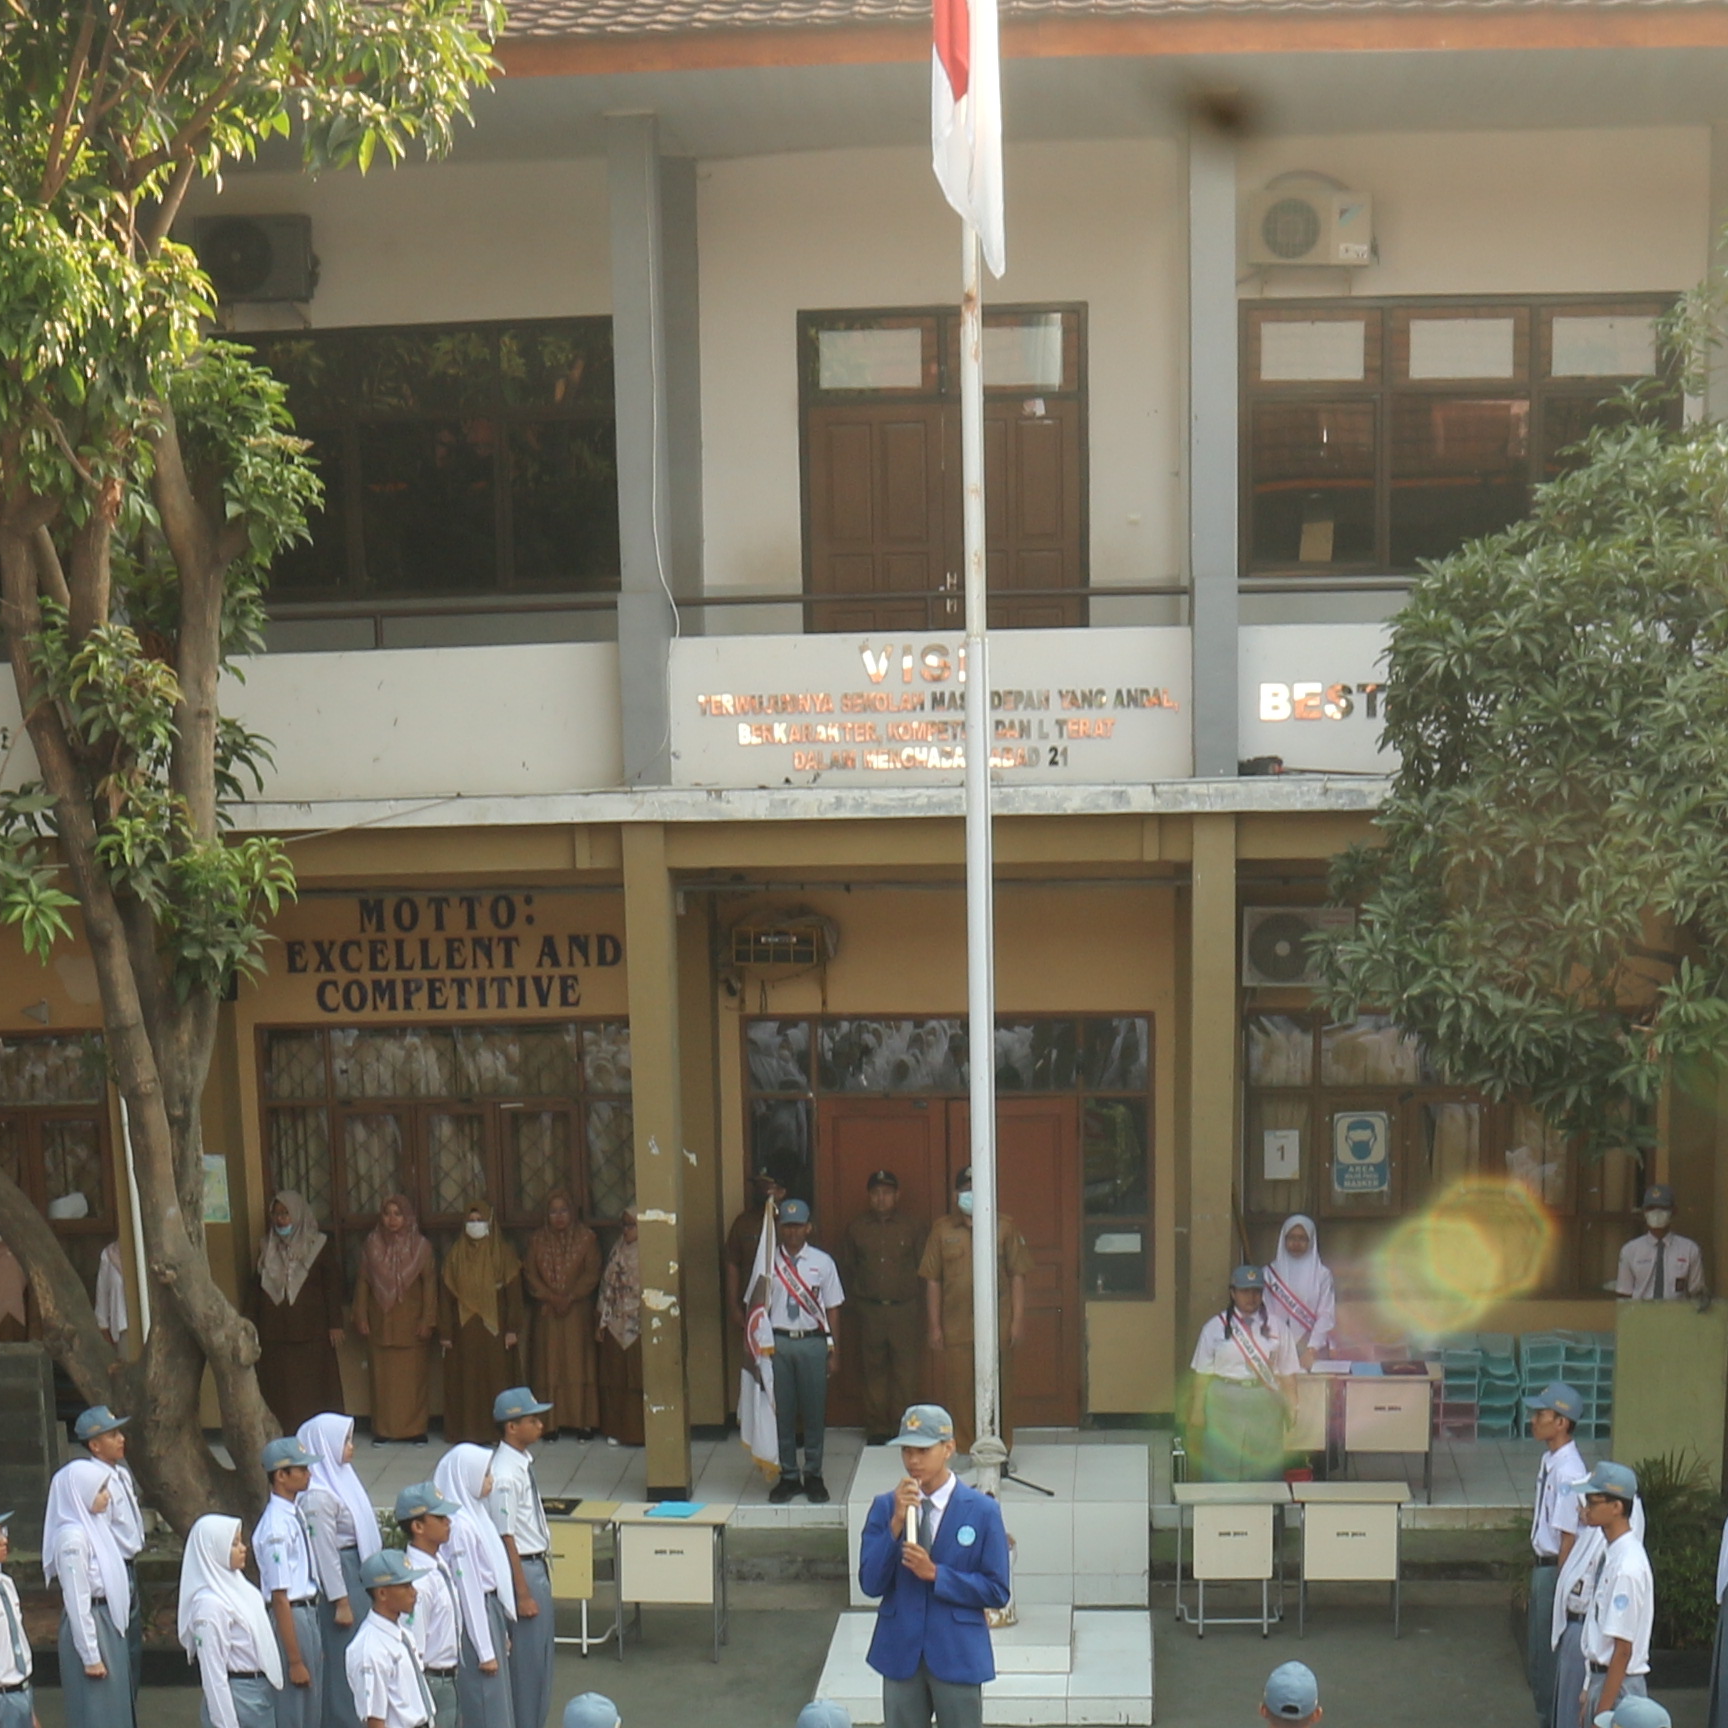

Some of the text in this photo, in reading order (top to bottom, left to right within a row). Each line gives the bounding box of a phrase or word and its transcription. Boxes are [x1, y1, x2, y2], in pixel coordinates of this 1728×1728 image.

[859, 643, 967, 684] VISI
[698, 687, 1180, 716] TERWUJUDNYA SEKOLAH MAS DEPAN YANG ANDAL,
[1259, 682, 1387, 721] BEST
[994, 719, 1032, 740] DAN
[793, 744, 1069, 771] DALAM MENGHADA ABAD 21
[358, 892, 536, 934] MOTTO:
[285, 932, 623, 976] EXCELLENT AND
[315, 973, 583, 1014] COMPETITIVE
